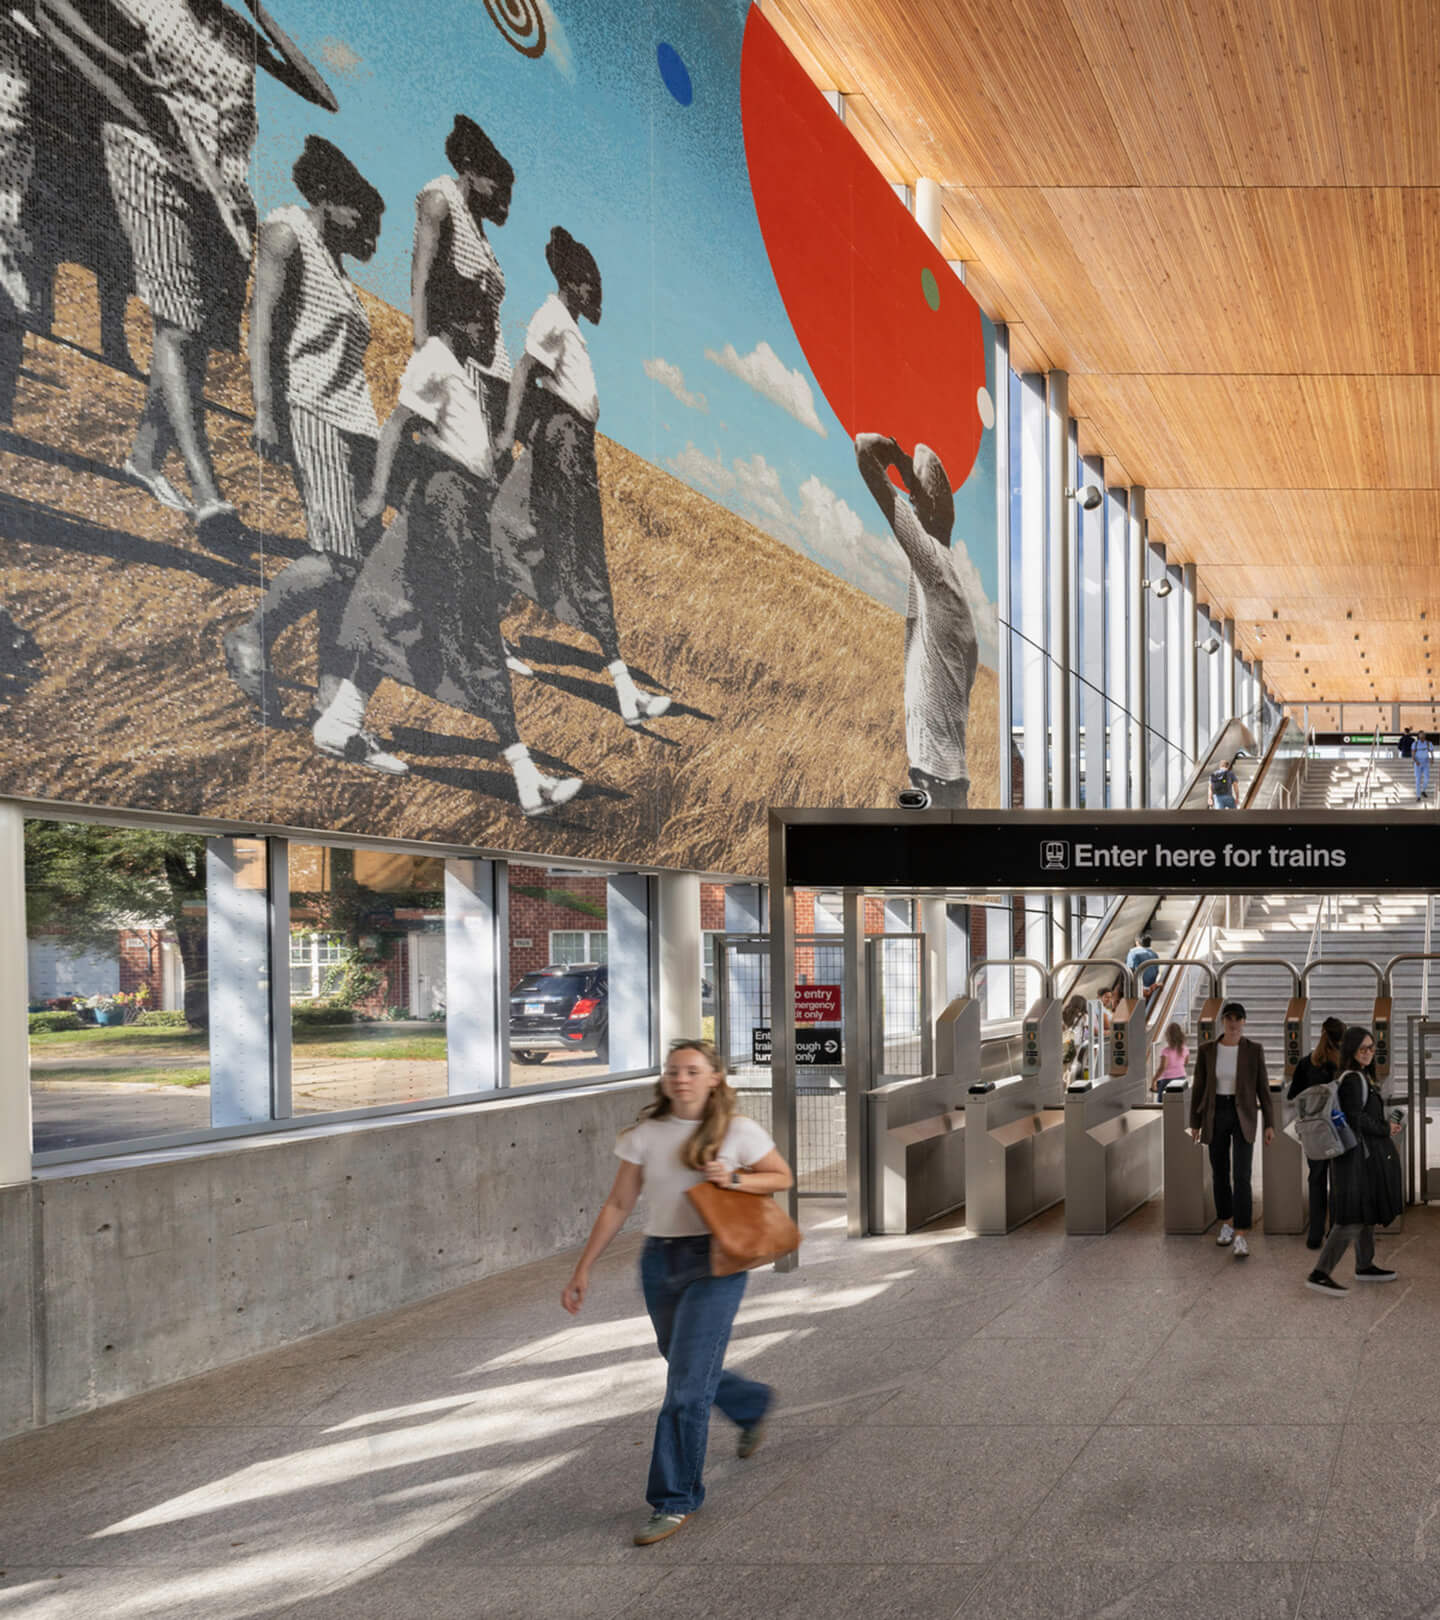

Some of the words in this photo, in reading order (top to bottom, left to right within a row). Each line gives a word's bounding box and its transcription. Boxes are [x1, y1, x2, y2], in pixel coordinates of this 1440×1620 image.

[1074, 844, 1148, 867] Enter
[1155, 844, 1216, 867] here
[1223, 844, 1262, 867] for
[1268, 844, 1347, 867] trains
[794, 991, 802, 999] o
[804, 989, 832, 1001] entry
[804, 1010, 824, 1020] only
[755, 1031, 771, 1041] Ent
[796, 1042, 821, 1052] ough
[795, 1053, 816, 1063] only
